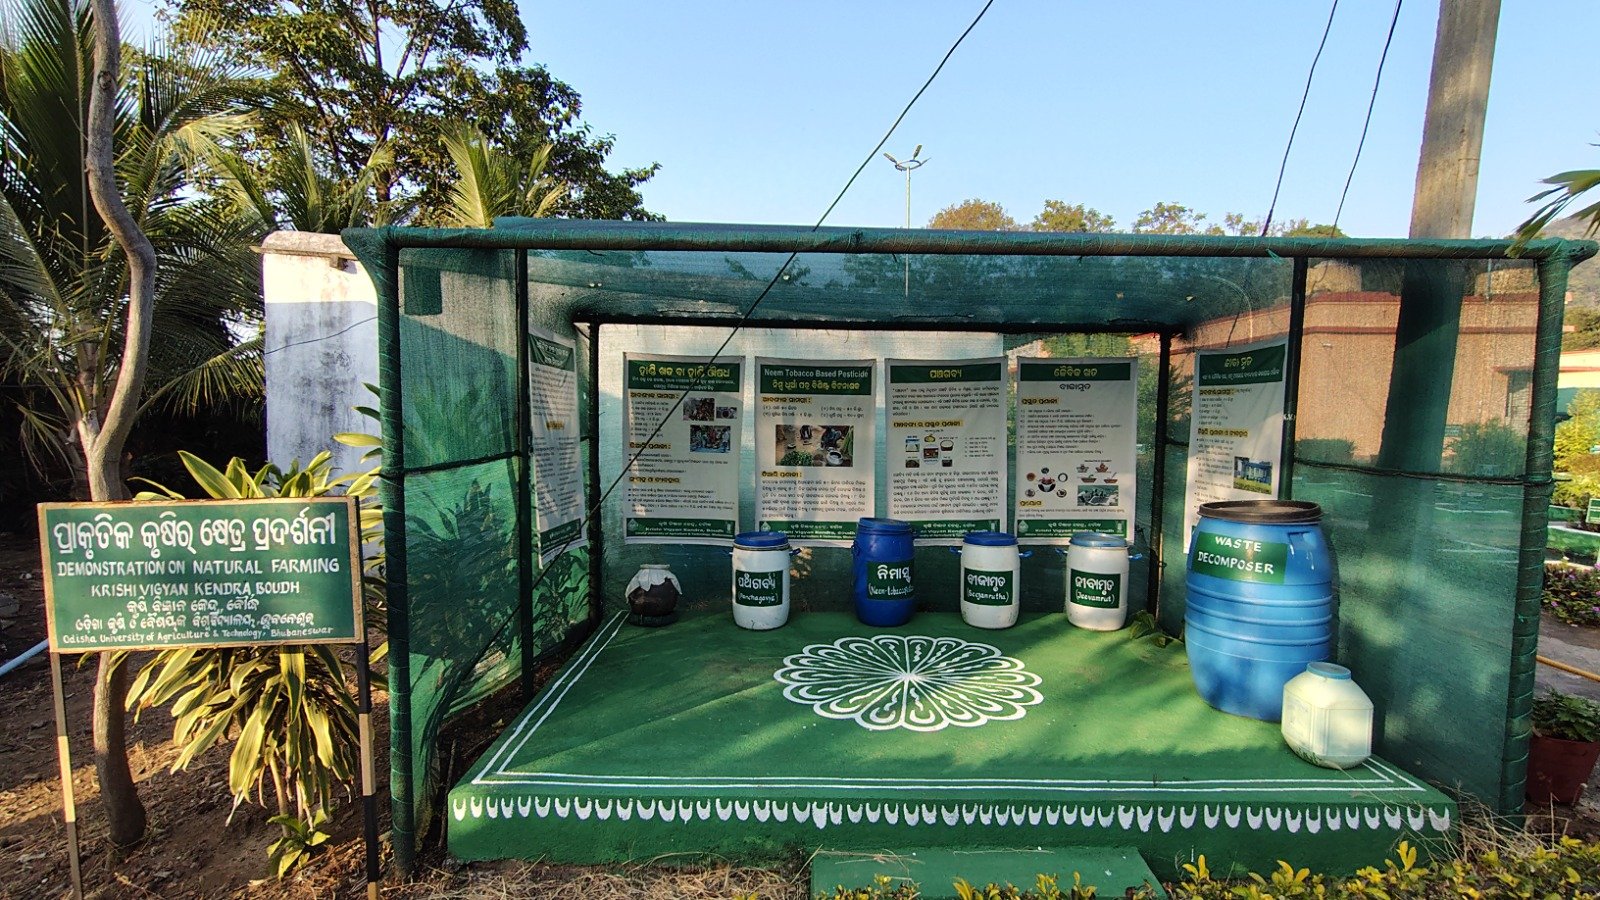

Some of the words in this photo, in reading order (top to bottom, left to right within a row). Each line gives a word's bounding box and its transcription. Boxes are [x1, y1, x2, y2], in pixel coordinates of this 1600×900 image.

[785, 369, 814, 377] Tobacco
[815, 370, 836, 378] Based
[838, 370, 868, 379] Pesticide
[53, 513, 134, 560] ପ୍ରାକୃତିକ
[140, 511, 197, 559] କୃଷିର
[252, 506, 336, 551] ପ୍ରଦର୍ଶନୀ
[1215, 536, 1262, 552] WASTE
[56, 560, 165, 577] DEMONSTRATION
[168, 560, 185, 575] ON
[193, 560, 263, 575] NATURAL
[272, 558, 340, 574] FARMING
[1197, 551, 1274, 575] DECOMPOSER
[91, 583, 137, 597] KRISHI
[139, 582, 188, 596] VIGYAN
[194, 581, 251, 595] KENDRA
[256, 581, 300, 594] BOUDH
[63, 634, 97, 644] Odisha
[100, 632, 145, 644] University
[146, 632, 154, 642] of
[157, 630, 210, 643] Agriculture
[213, 629, 219, 637] &
[222, 629, 266, 640] Technology,
[271, 626, 333, 638] Bhubaneswar
